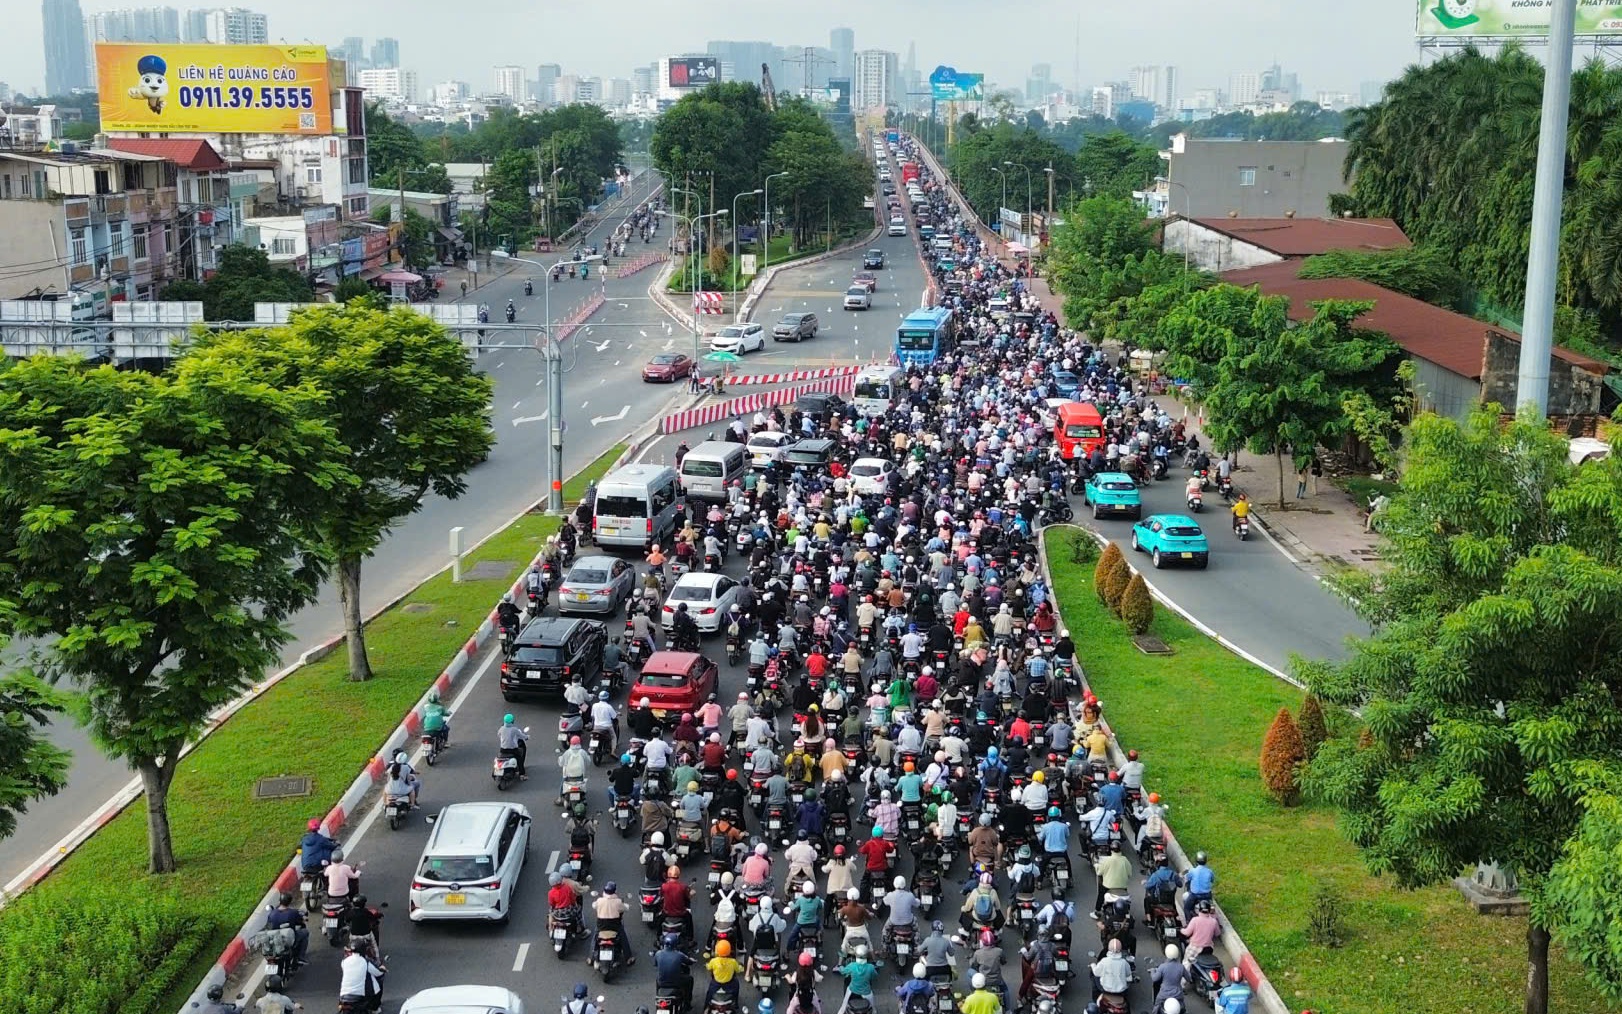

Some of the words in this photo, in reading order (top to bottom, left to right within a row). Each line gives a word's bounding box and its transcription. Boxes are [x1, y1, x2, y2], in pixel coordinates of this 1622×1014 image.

[178, 65, 204, 80] LIÊN
[209, 65, 224, 83] HỆ
[228, 65, 268, 80] QUẢNG
[179, 86, 313, 108] 0911.39.5555
